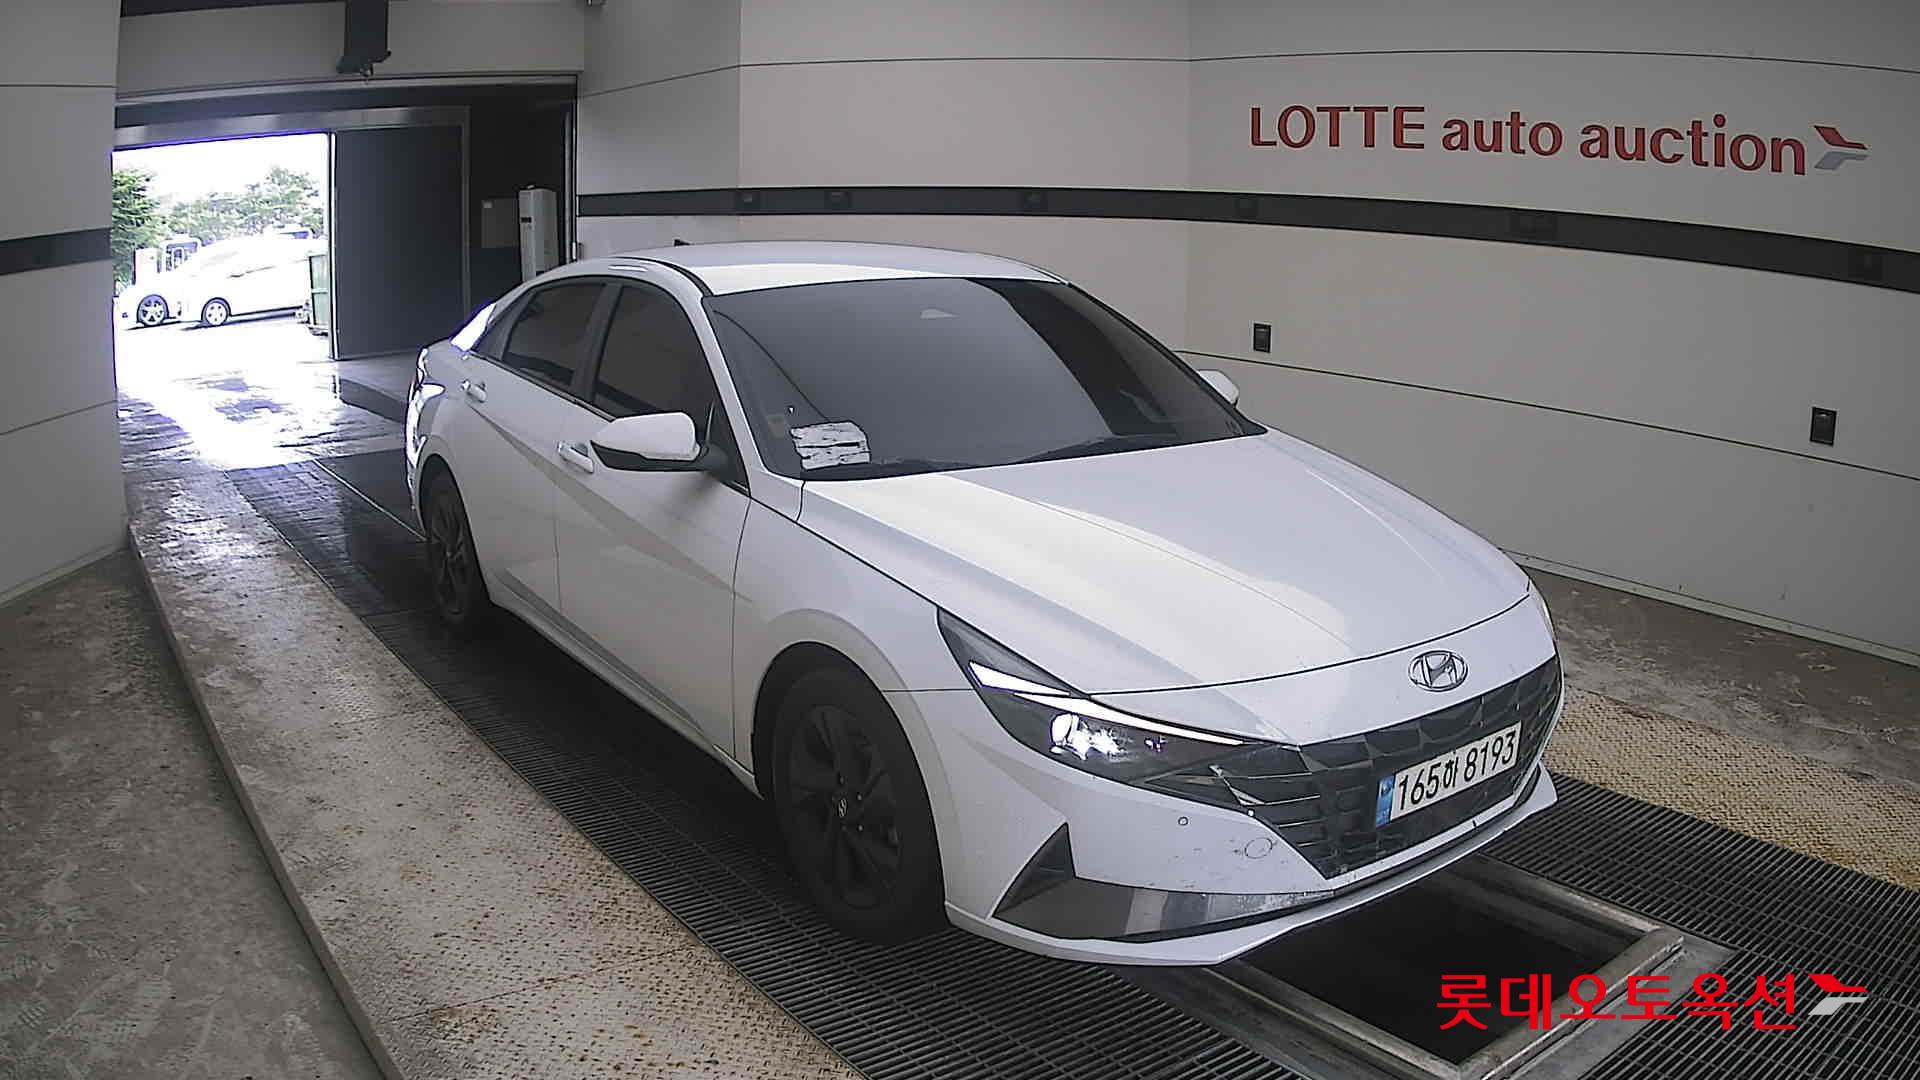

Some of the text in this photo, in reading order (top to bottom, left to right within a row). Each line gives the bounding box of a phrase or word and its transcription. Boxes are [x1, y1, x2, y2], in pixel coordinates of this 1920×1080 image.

[1250, 105, 1807, 176] LOTTE auto auction
[1463, 730, 1517, 782] 8193
